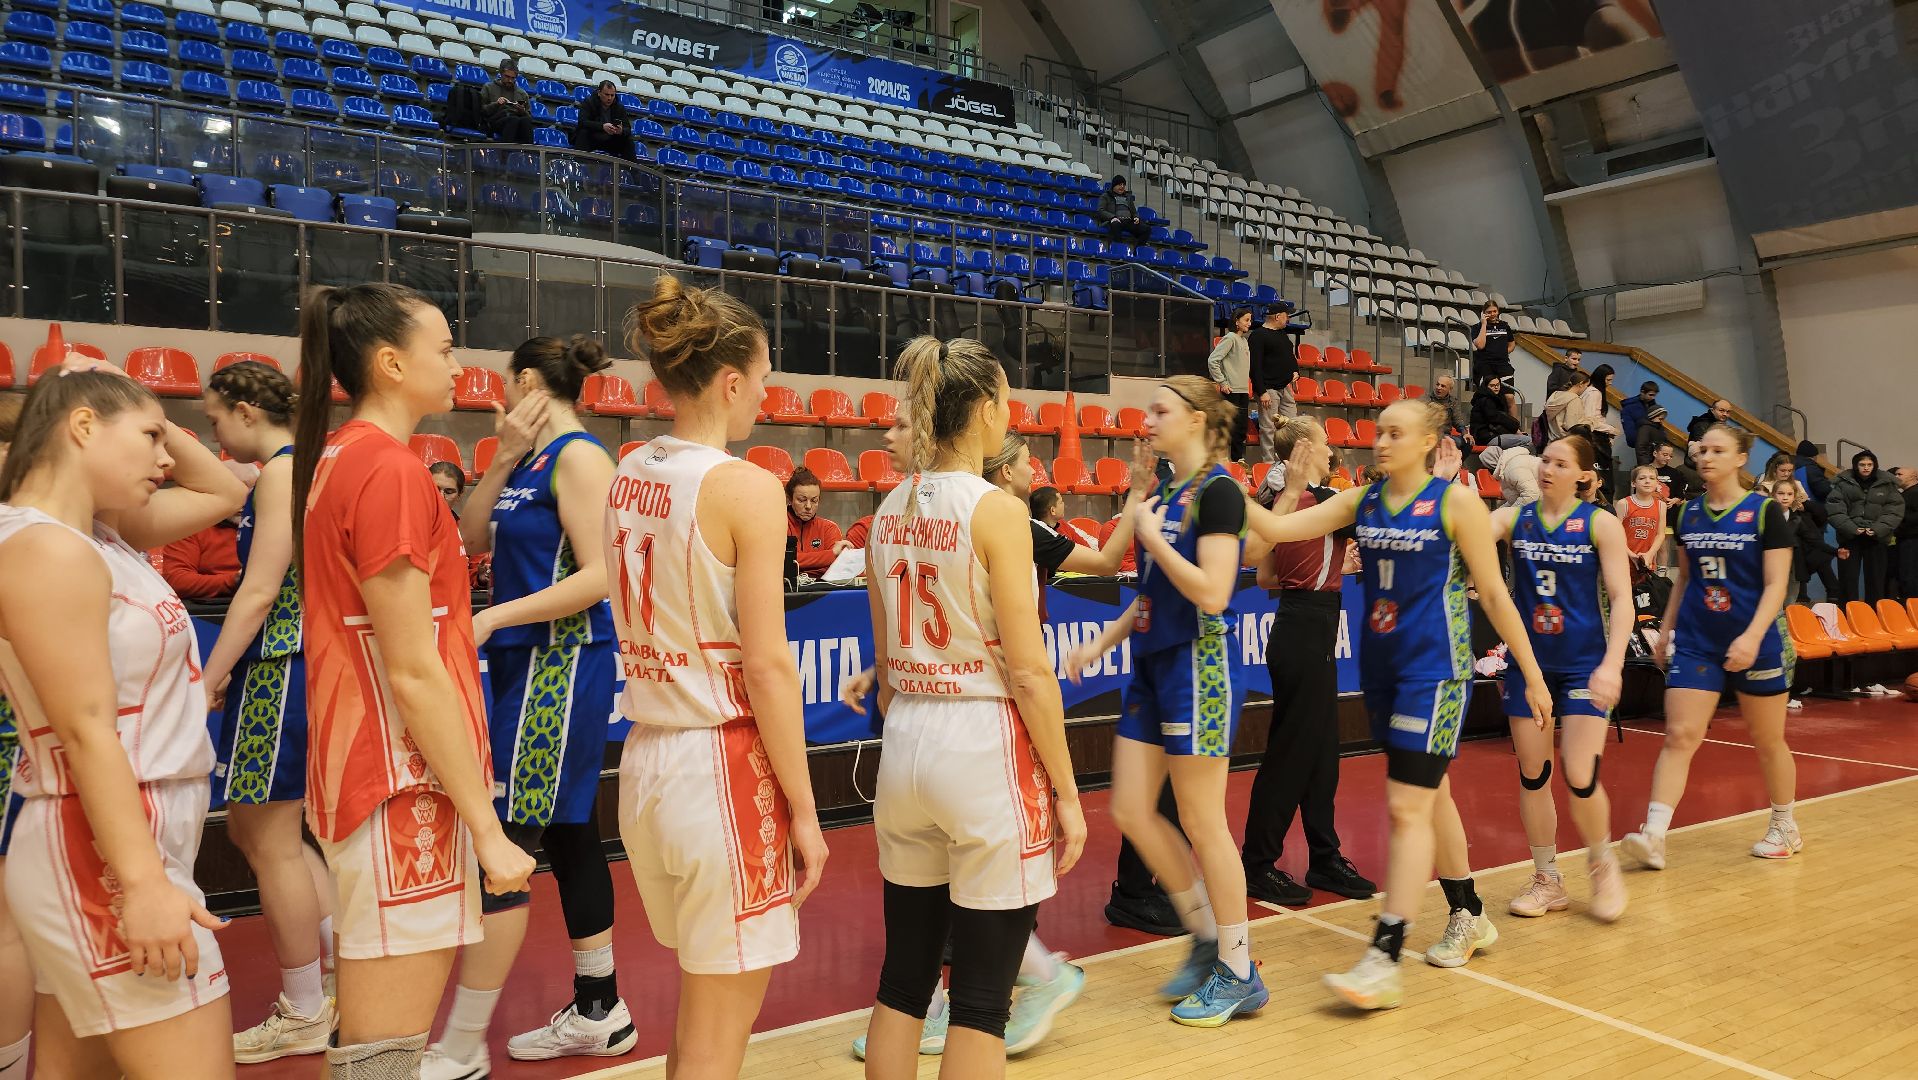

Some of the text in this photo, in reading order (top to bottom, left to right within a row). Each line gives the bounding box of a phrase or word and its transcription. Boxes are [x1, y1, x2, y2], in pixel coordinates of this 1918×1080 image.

[632, 29, 720, 62] FONBET
[867, 76, 911, 102] 2024/25
[945, 94, 1006, 118] JÖGEL
[612, 526, 656, 635] 11
[1377, 559, 1395, 591] 11
[1698, 556, 1728, 579] 21
[1535, 569, 1557, 597] 3
[886, 558, 952, 651] 15
[887, 657, 984, 676] МОСКОВСКАЯ
[899, 678, 962, 695] ОБЛАСТЬ
